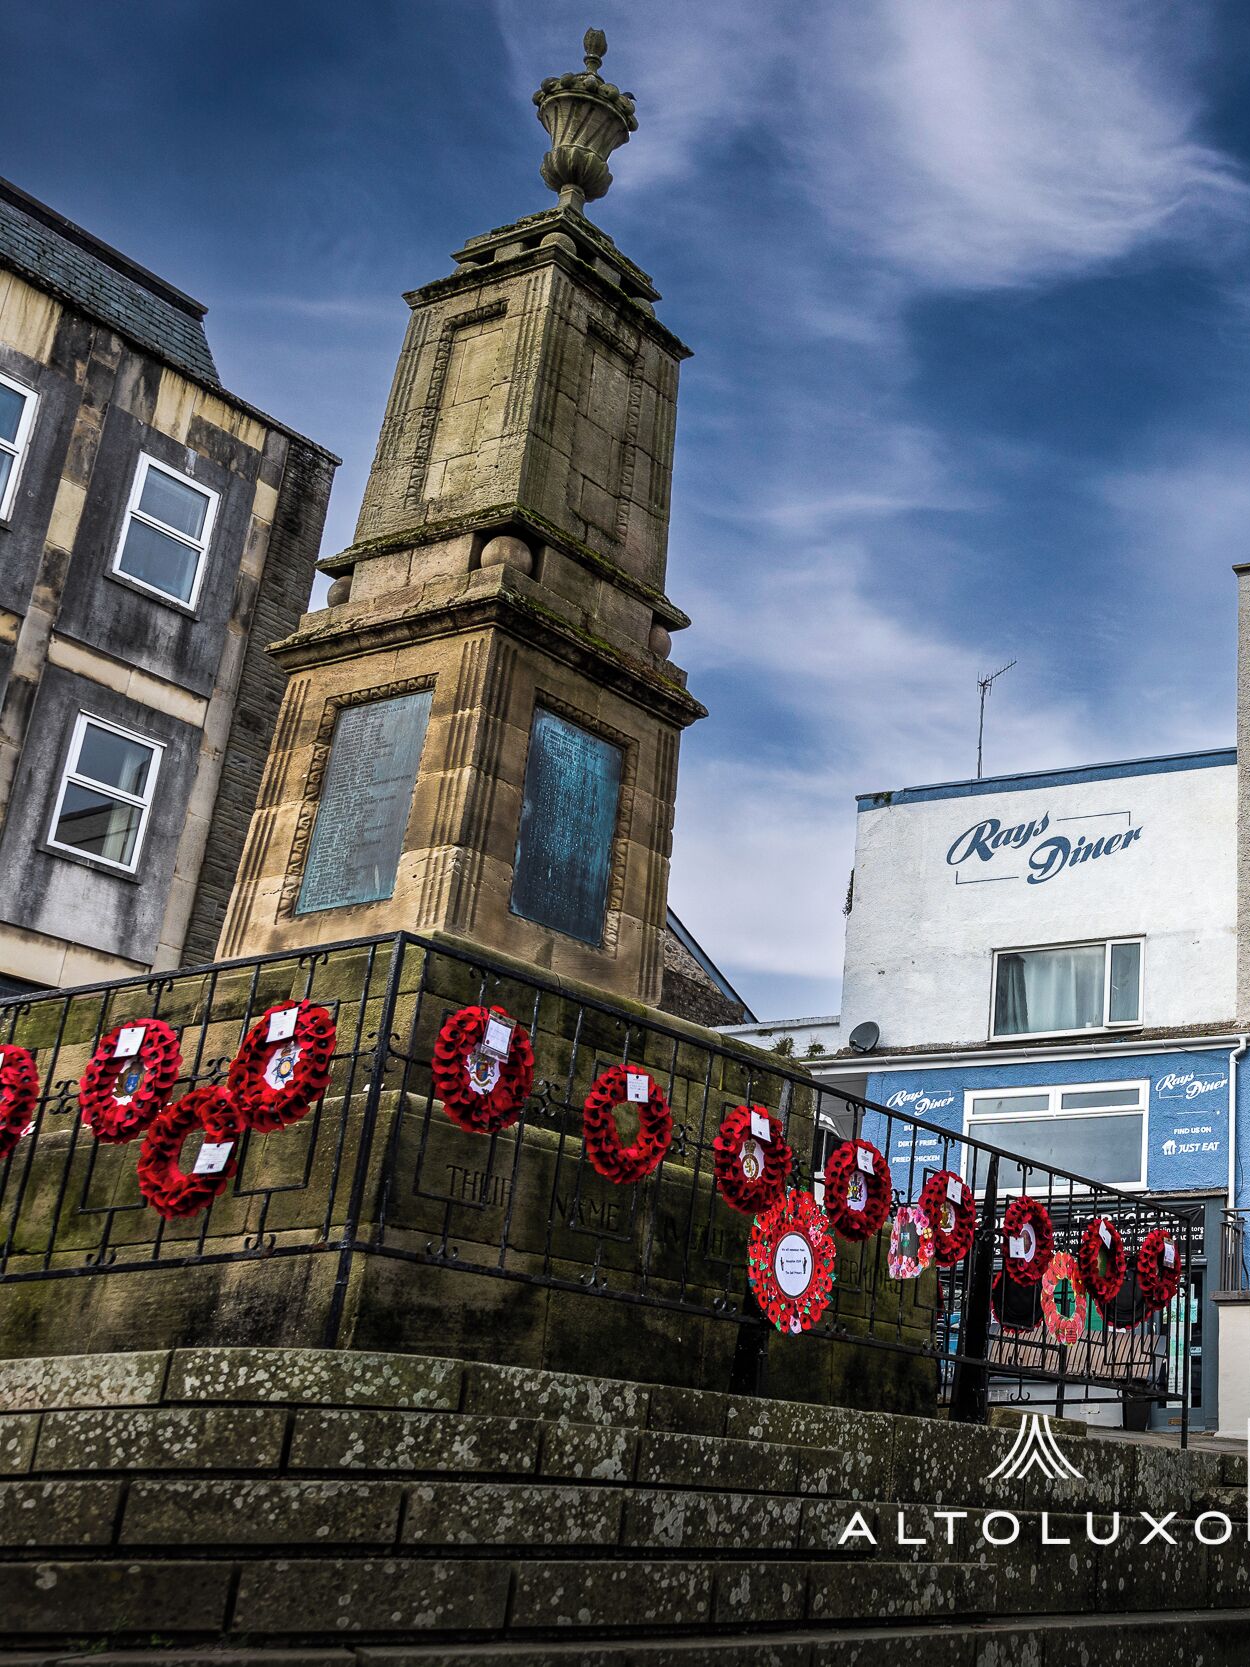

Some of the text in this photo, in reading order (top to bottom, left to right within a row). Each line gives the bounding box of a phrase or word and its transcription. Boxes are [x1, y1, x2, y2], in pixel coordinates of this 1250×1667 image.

[946, 810, 1051, 866] Rays
[1026, 825, 1144, 885] Diner
[1155, 1071, 1194, 1092] Rays
[1185, 1078, 1228, 1100] Diner
[886, 1088, 924, 1108] Rays
[914, 1095, 954, 1116] Diner
[919, 1139, 937, 1147] FRIES
[1178, 1141, 1220, 1154] JUST EAT
[892, 1156, 911, 1164] FRIED
